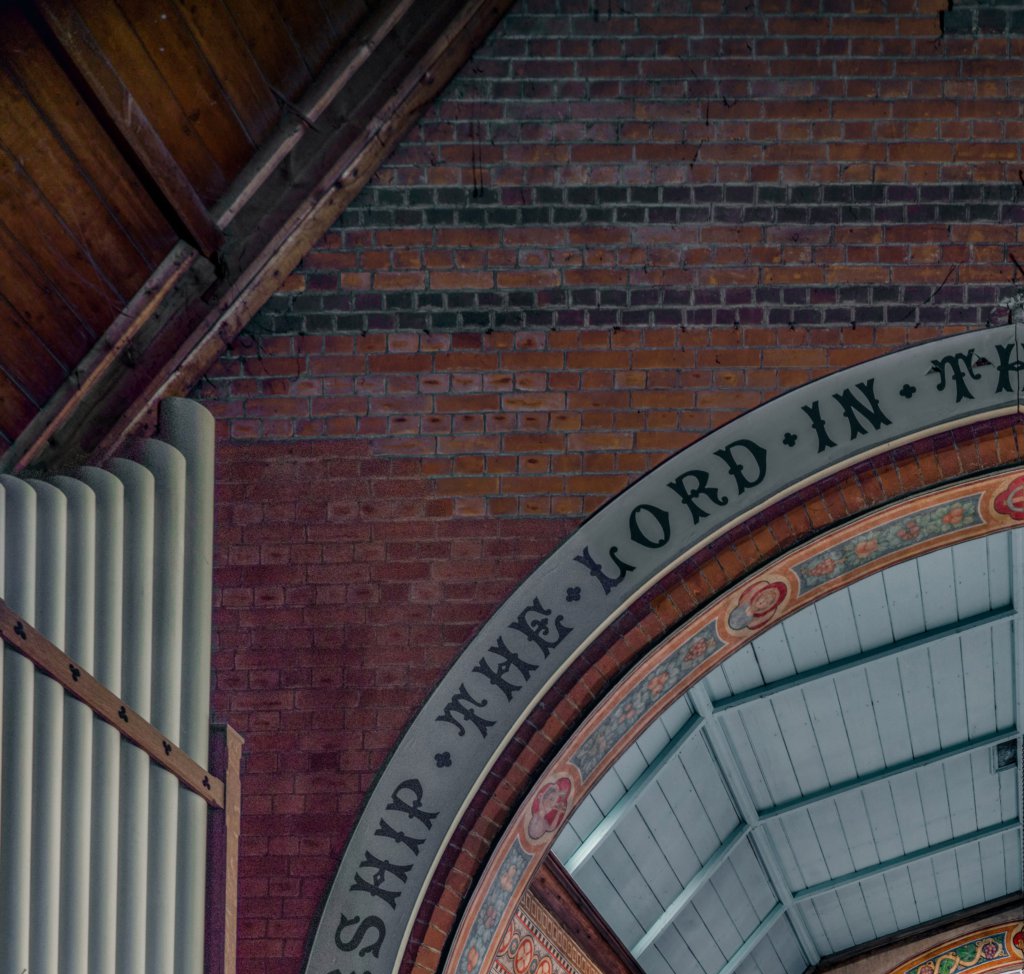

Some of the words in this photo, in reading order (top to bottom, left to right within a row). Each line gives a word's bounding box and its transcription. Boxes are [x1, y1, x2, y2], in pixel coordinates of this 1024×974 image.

[434, 597, 573, 740] THE
[573, 437, 770, 597] LORD
[801, 377, 892, 454] IN
